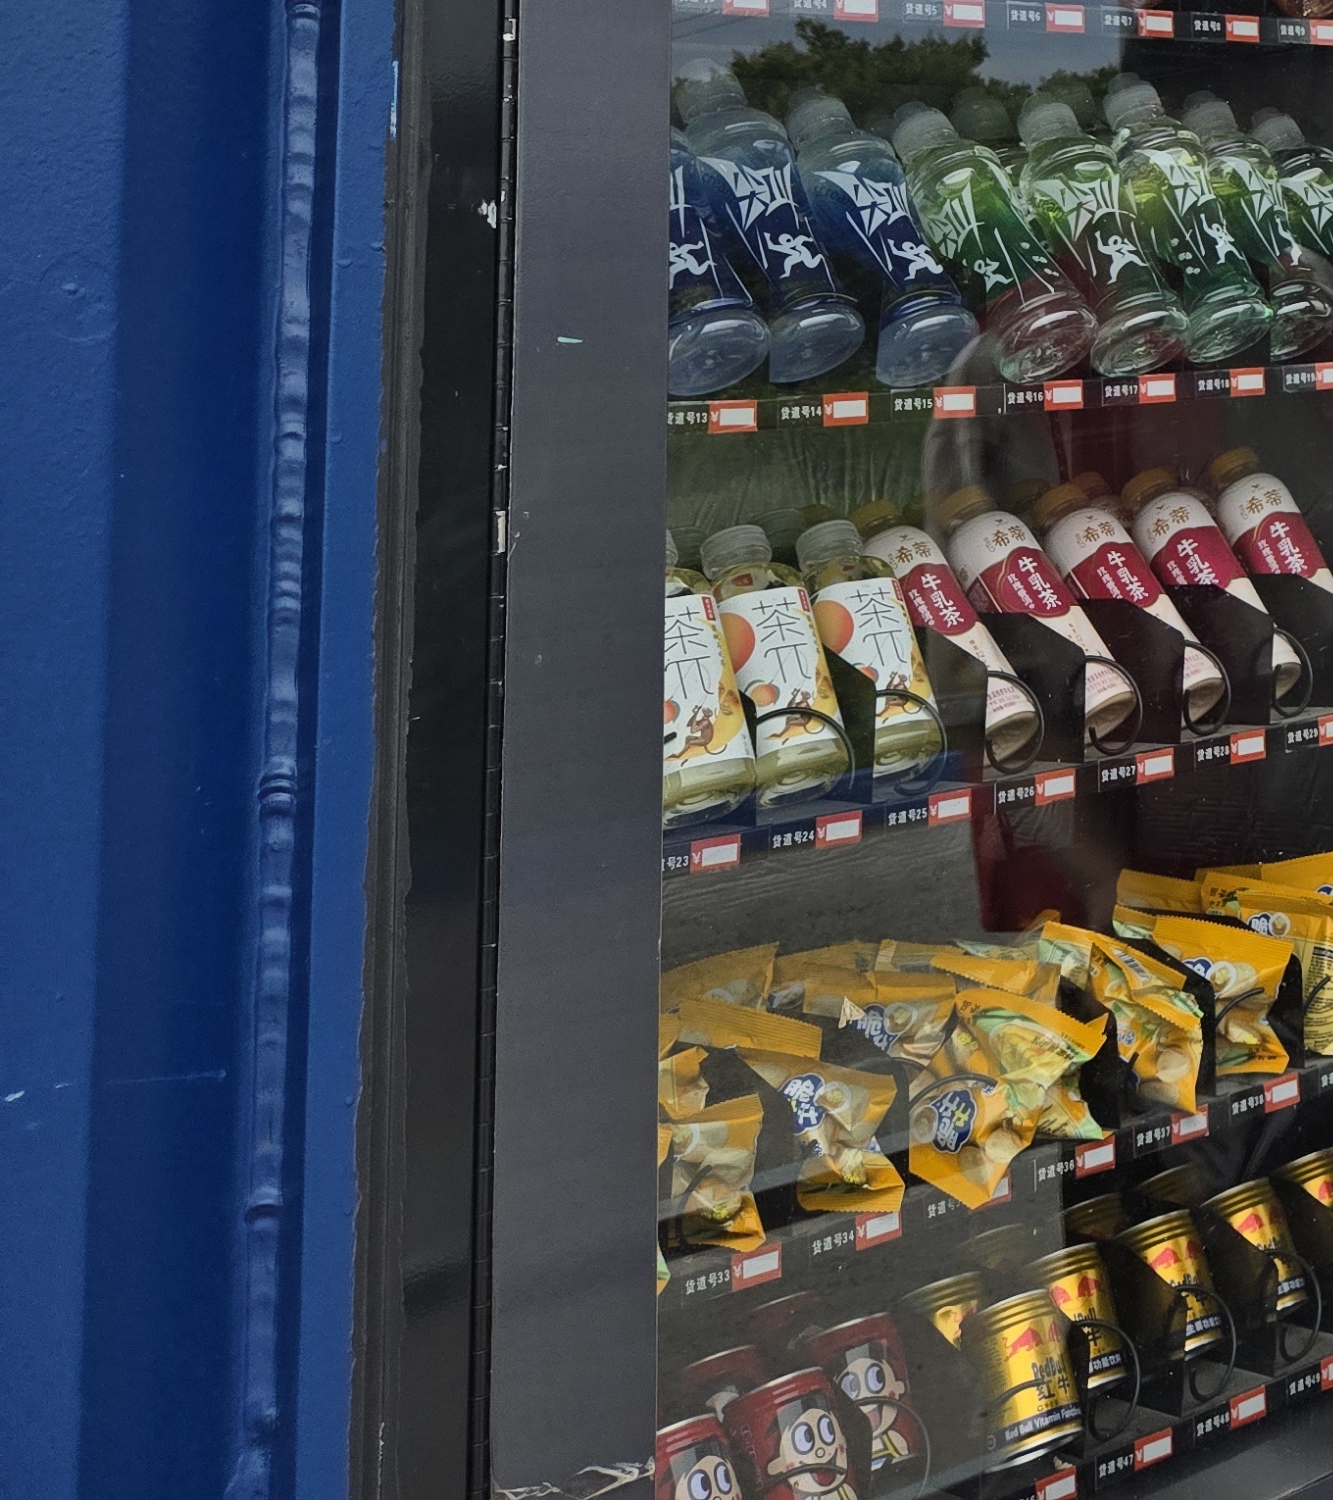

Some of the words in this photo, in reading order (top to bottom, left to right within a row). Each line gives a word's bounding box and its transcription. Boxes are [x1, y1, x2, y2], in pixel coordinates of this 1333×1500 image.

[920, 573, 965, 628] 牛乳茶
[1018, 556, 1062, 610] 牛乳茶
[1106, 550, 1149, 603] 牛乳茶
